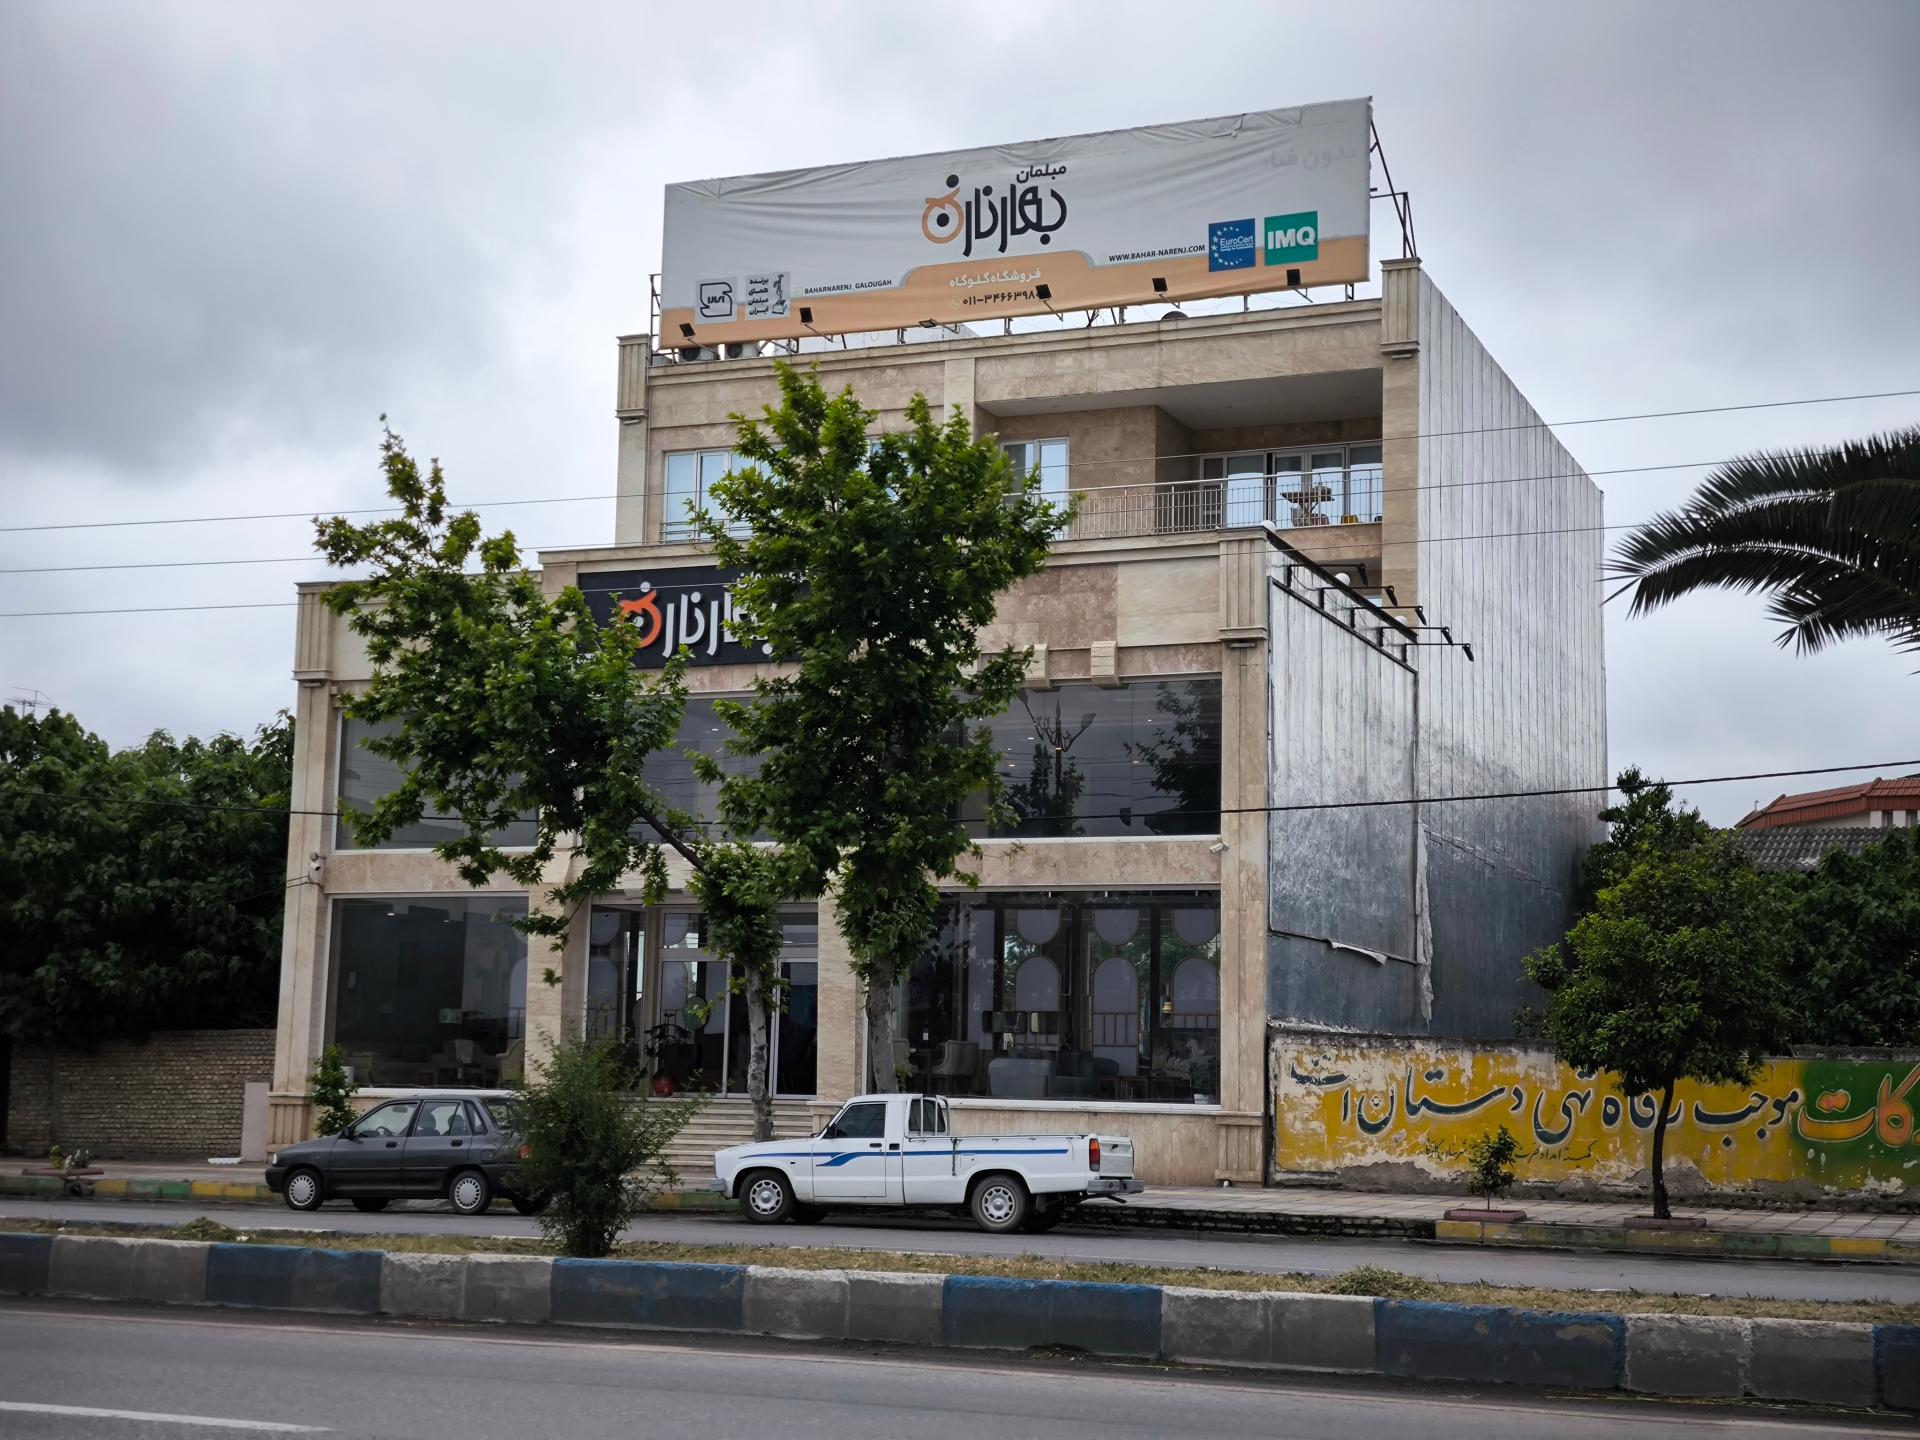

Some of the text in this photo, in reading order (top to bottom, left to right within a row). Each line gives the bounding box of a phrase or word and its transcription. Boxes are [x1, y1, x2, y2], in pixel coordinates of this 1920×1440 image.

[1016, 163, 1067, 183] مبلمان
[1220, 235, 1254, 248] EuroCert
[1267, 226, 1316, 250] IMQ
[1108, 244, 1206, 262] WWW.BAHAR-NARENJ.COM
[804, 279, 892, 294] BAHARNARENJ_GALOUGAH
[949, 268, 1041, 288] فروشگاه گلوگاه
[962, 289, 1040, 306] ۰۱۱-۳۴۶۶۳۹۸
[748, 305, 769, 315] ایران
[1532, 1068, 1597, 1147] تهی
[1694, 1089, 1801, 1148] موجب
